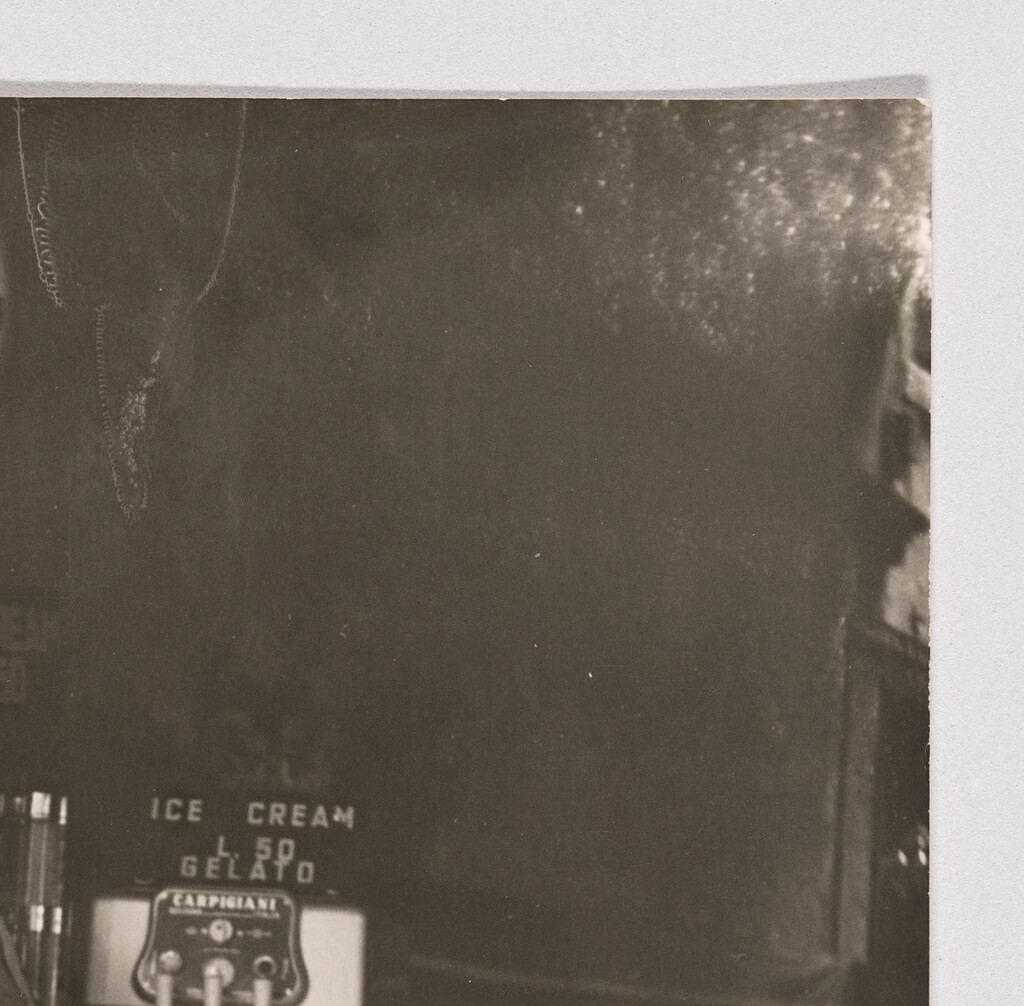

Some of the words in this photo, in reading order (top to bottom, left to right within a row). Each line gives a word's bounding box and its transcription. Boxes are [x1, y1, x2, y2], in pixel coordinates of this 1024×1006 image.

[151, 797, 203, 823] ICE
[246, 801, 355, 830] CREAM
[255, 836, 296, 863] 50
[180, 855, 315, 884] GELATO
[172, 893, 277, 911] CARPIGIANI
